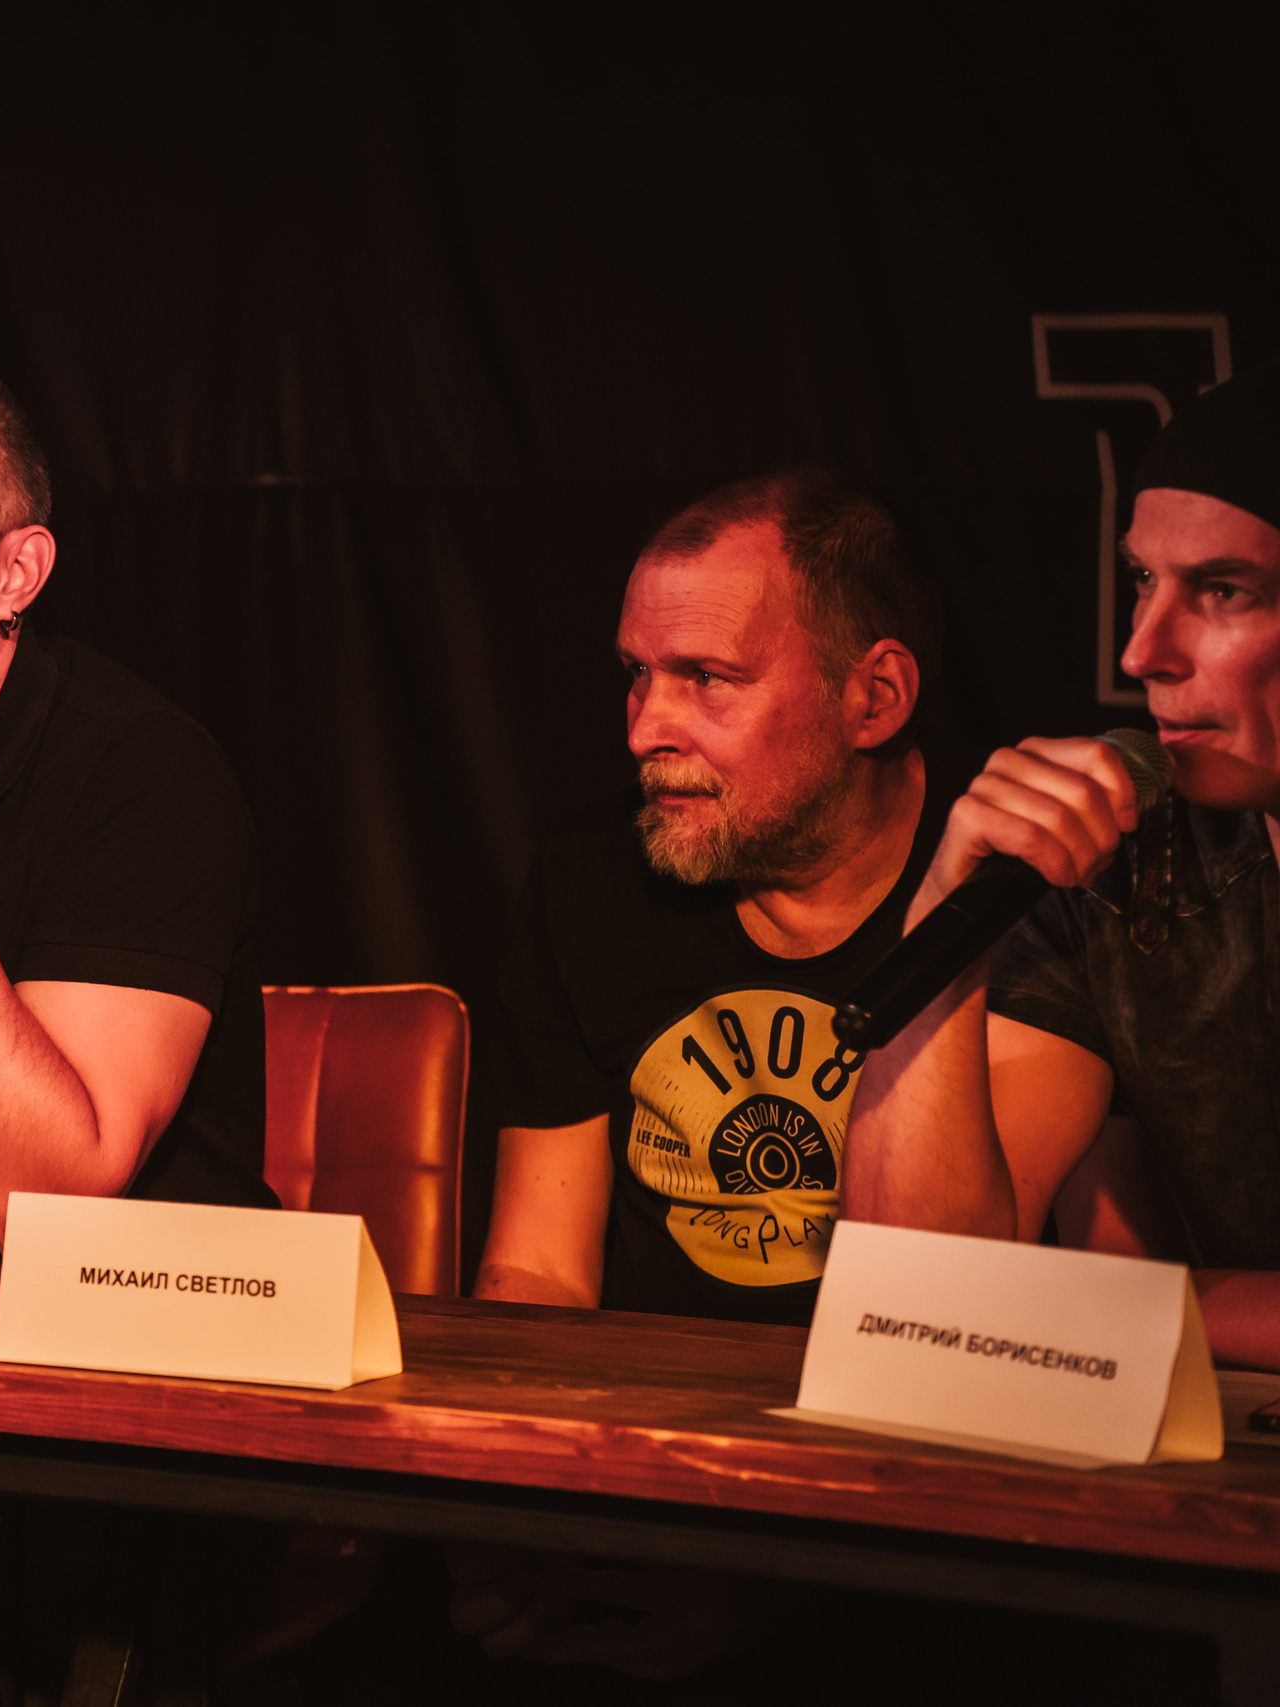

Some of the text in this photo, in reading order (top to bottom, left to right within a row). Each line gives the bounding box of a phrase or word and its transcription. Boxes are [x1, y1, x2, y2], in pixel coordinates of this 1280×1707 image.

[682, 1006, 867, 1102] 1908
[636, 1128, 691, 1159] LEE COOPER
[717, 1104, 823, 1158] LONDON IS IN
[80, 1267, 276, 1298] МИХАИЛ СВЕТЛОВ
[857, 1313, 1119, 1381] ДМИТРИЙ БОРИСЕНКОВ
